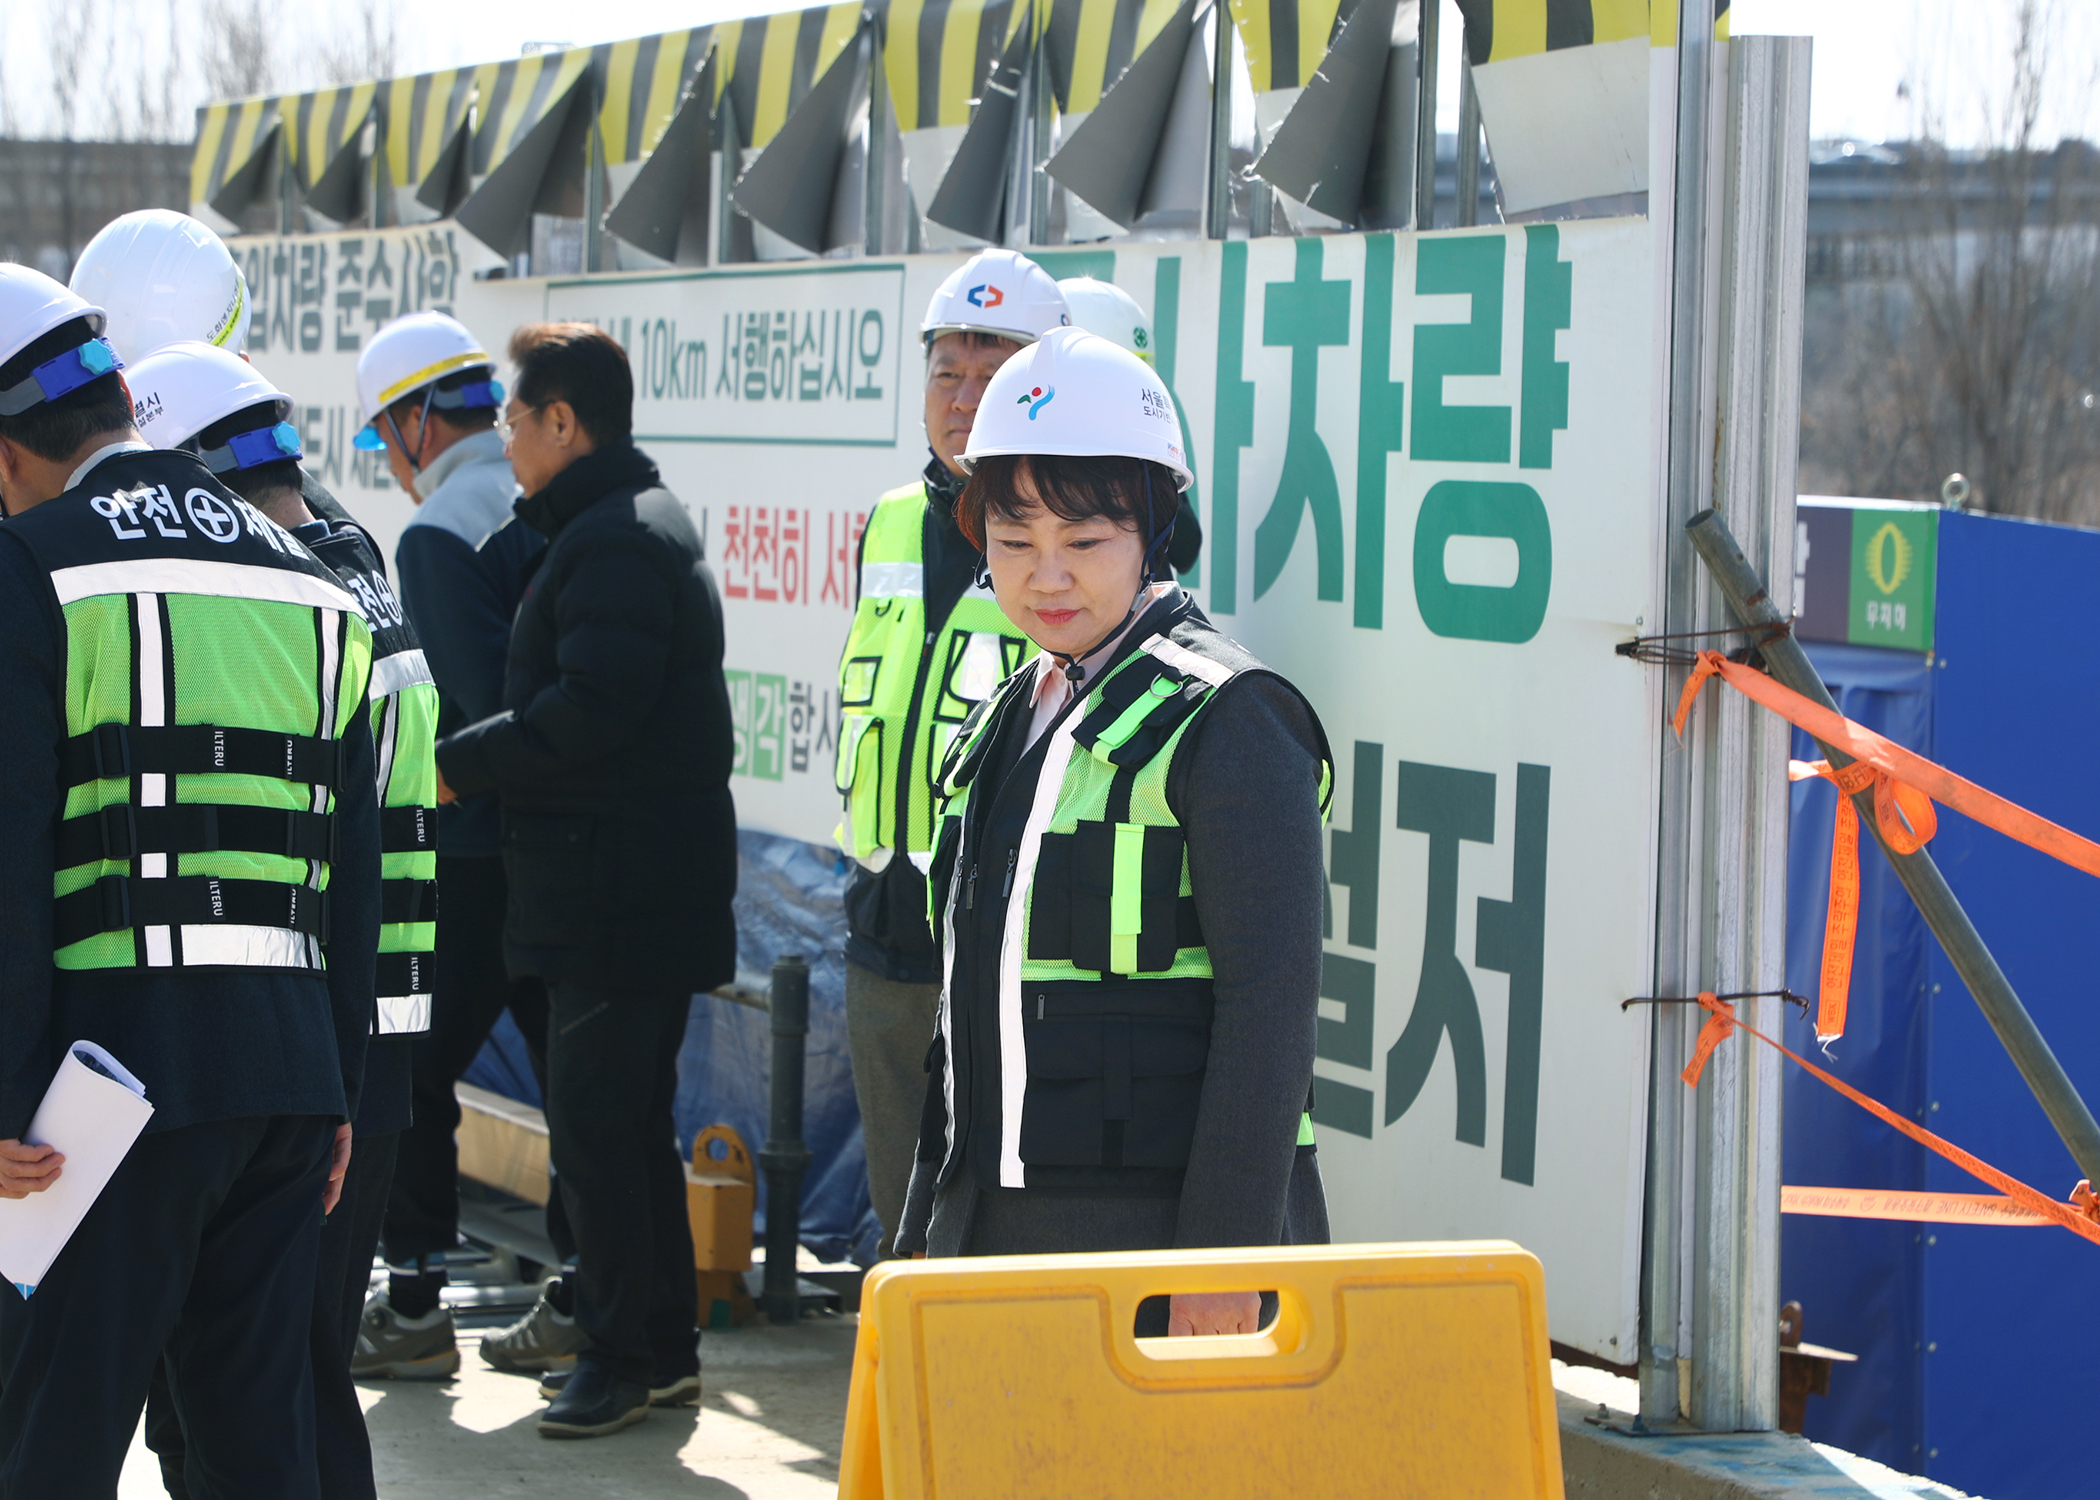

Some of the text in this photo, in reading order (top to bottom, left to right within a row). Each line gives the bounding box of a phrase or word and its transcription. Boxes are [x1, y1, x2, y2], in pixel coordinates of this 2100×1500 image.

[641, 316, 708, 400] 10km
[716, 308, 884, 402] 서행하십시오
[1023, 222, 1573, 645] 사차량
[90, 484, 188, 540] 안전
[723, 504, 809, 606] 천천히
[820, 510, 866, 610] 서
[214, 730, 225, 767] ILTERU
[416, 809, 426, 843] ILTERU
[209, 880, 224, 917] ILTERU
[411, 956, 420, 991] ILTERU
